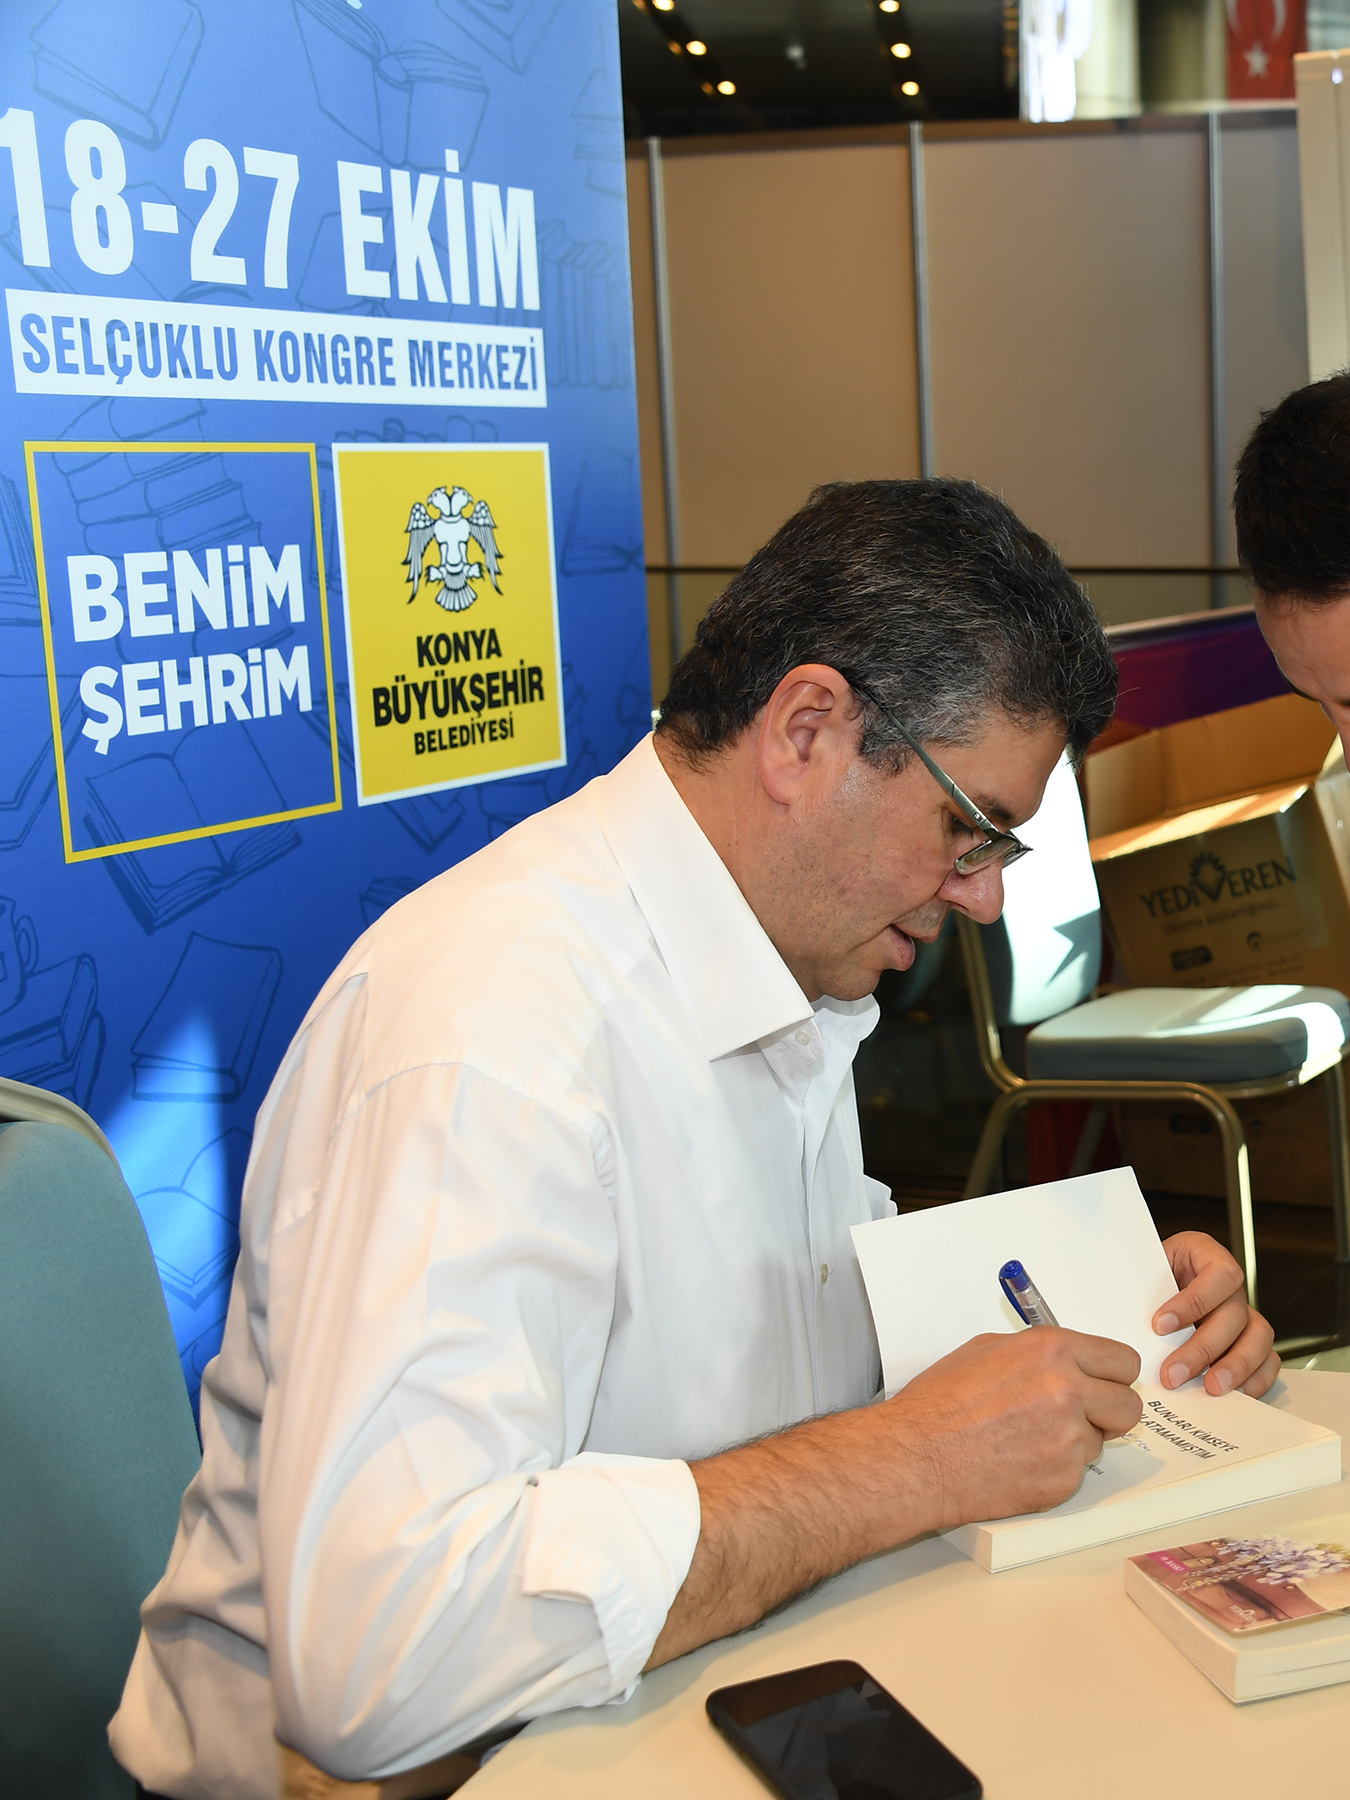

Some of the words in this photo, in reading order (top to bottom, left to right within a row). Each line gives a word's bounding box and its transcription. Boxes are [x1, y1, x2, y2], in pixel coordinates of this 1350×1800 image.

[0, 106, 300, 290] 18-27
[337, 148, 540, 312] EKİM
[20, 312, 239, 386] SELÇUKLU
[252, 328, 397, 387] KONGRE
[408, 336, 539, 392] MERKEZİ
[415, 627, 503, 669] KONYA
[371, 665, 546, 728] BÜYÜKŞEHİR
[413, 716, 516, 756] BELEDİYESİ
[1147, 1400, 1197, 1432] BUNLARI
[1191, 1428, 1240, 1453] KİMSEYE
